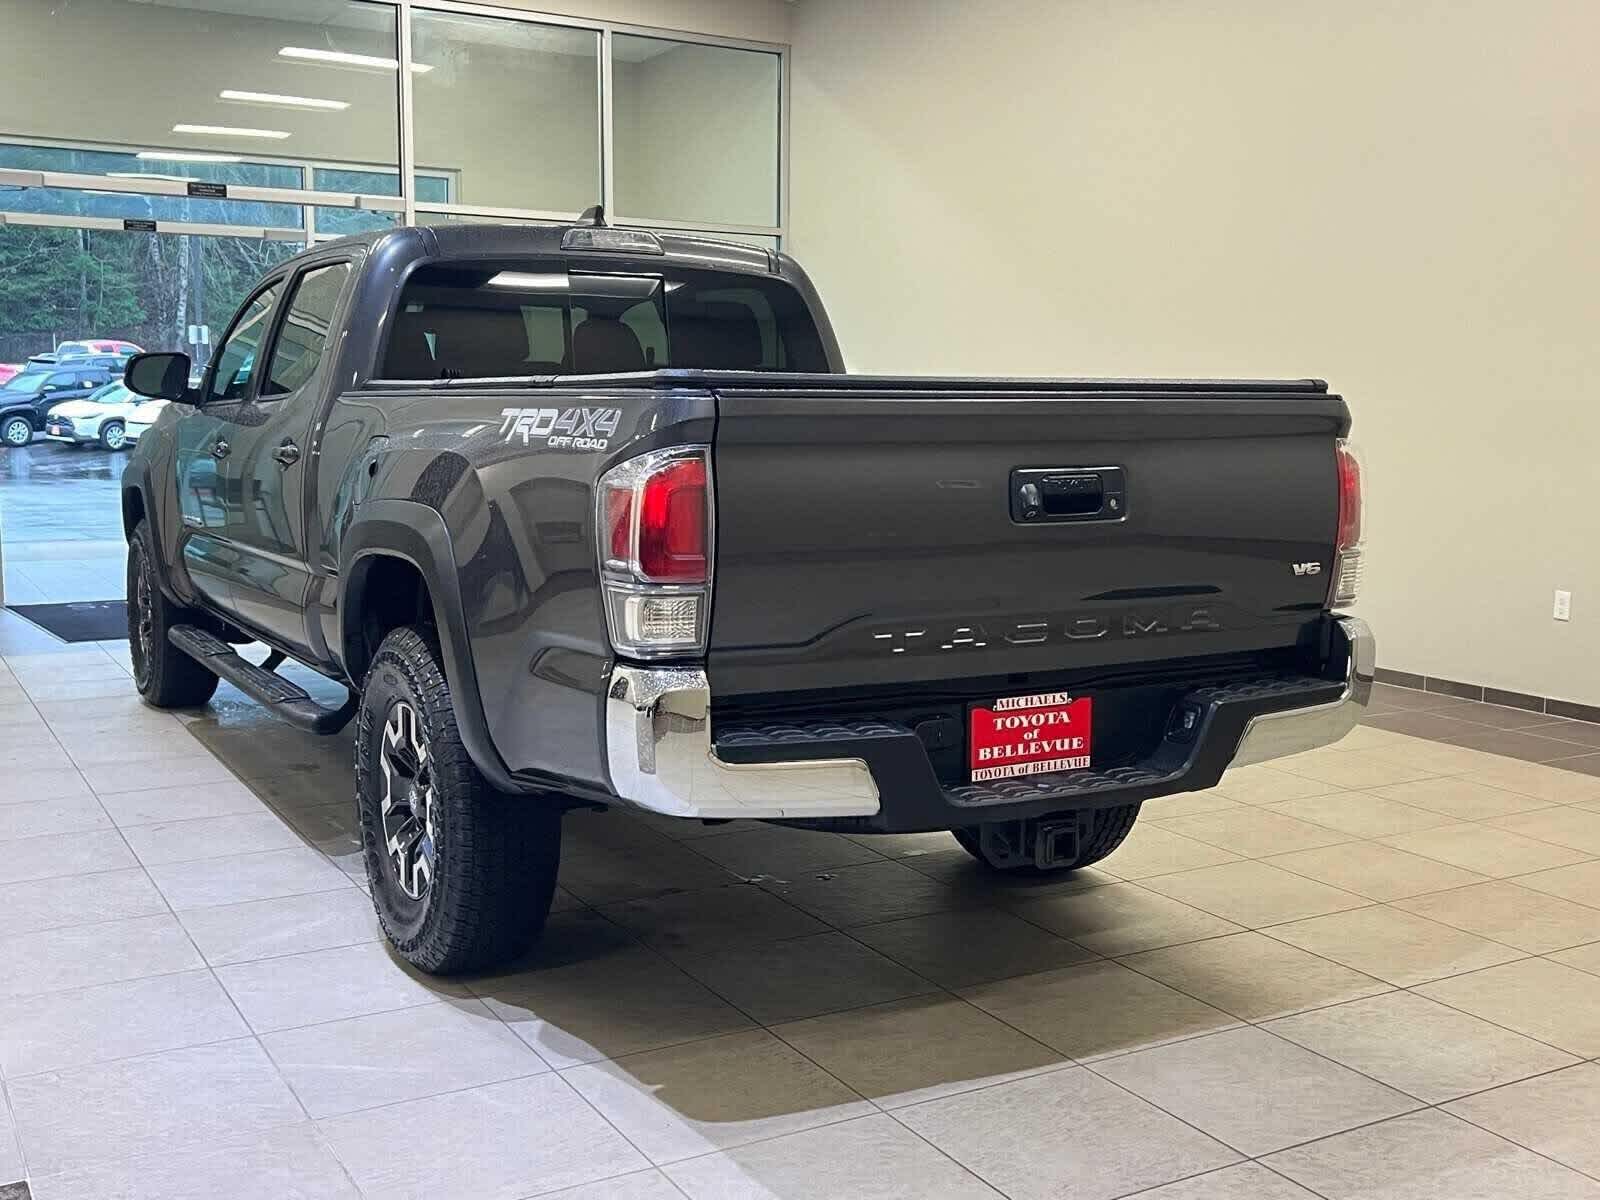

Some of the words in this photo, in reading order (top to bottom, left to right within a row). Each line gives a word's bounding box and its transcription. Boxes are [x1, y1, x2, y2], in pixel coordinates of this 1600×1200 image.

[500, 408, 559, 443] TRD
[547, 435, 574, 446] OFF
[572, 437, 608, 450] ROAD
[1292, 562, 1321, 576] V6
[873, 608, 1221, 653] TACOMA
[999, 692, 1066, 710] MICHAELS
[993, 711, 1071, 730] TOYOTA
[1023, 729, 1040, 740] of
[978, 737, 1084, 760] BELLEVUE
[973, 767, 1015, 781] TOYOTA
[1018, 766, 1029, 775] of
[1032, 757, 1089, 772] BELLEVUE
